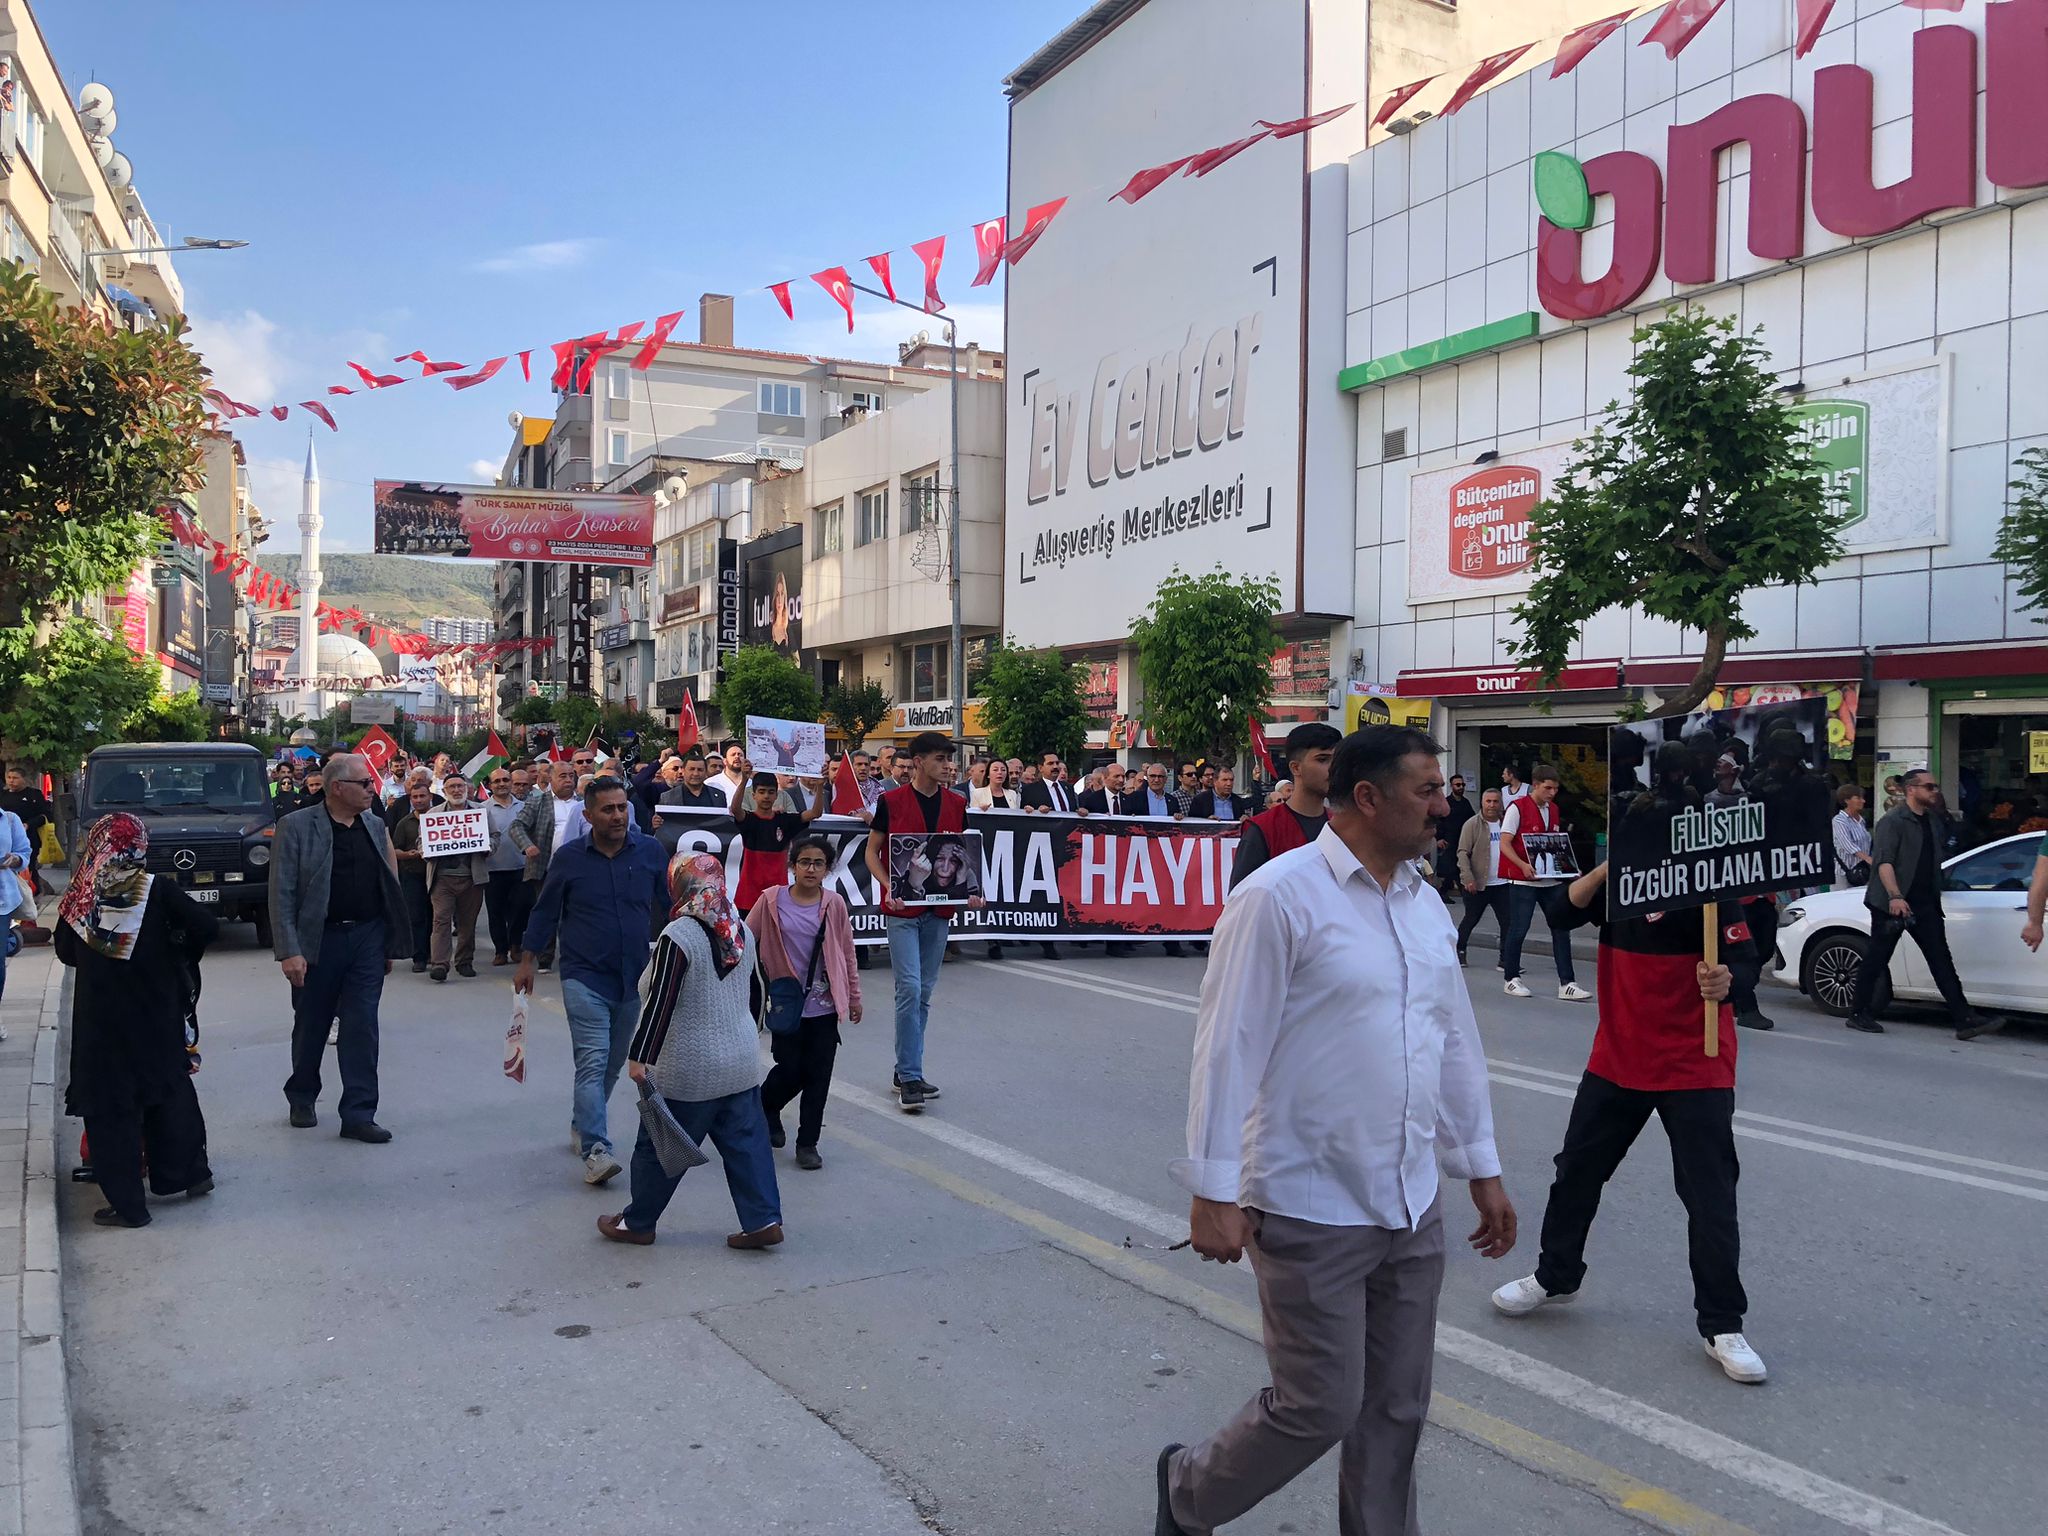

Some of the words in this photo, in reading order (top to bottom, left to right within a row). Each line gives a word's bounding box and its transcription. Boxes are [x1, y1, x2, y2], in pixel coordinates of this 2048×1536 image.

[1027, 379, 1081, 506] Ev
[1087, 311, 1263, 488] Center
[1456, 477, 1535, 508] Bütçenizin
[474, 499, 501, 509] TÜRK
[503, 502, 535, 511] SANAT
[538, 502, 573, 513] MÜZİĞİ
[1454, 505, 1504, 529] değerini
[468, 512, 549, 541] Bahar
[1033, 514, 1115, 569] Alışveriş
[1121, 472, 1244, 546] Merkezleri
[1481, 520, 1535, 546] onur
[1496, 542, 1530, 566] bilir
[1476, 677, 1521, 691] onur
[425, 813, 482, 828] DEVLET
[1671, 797, 1765, 854] FİLİSTİN
[428, 824, 483, 842] DEĞİL,
[428, 839, 484, 852] TERÖRİST
[1619, 858, 1688, 906] ÖZGÜR
[1694, 851, 1765, 892] OLANA
[1771, 842, 1823, 879] DEK!
[964, 910, 1058, 928] PLATFORMU
